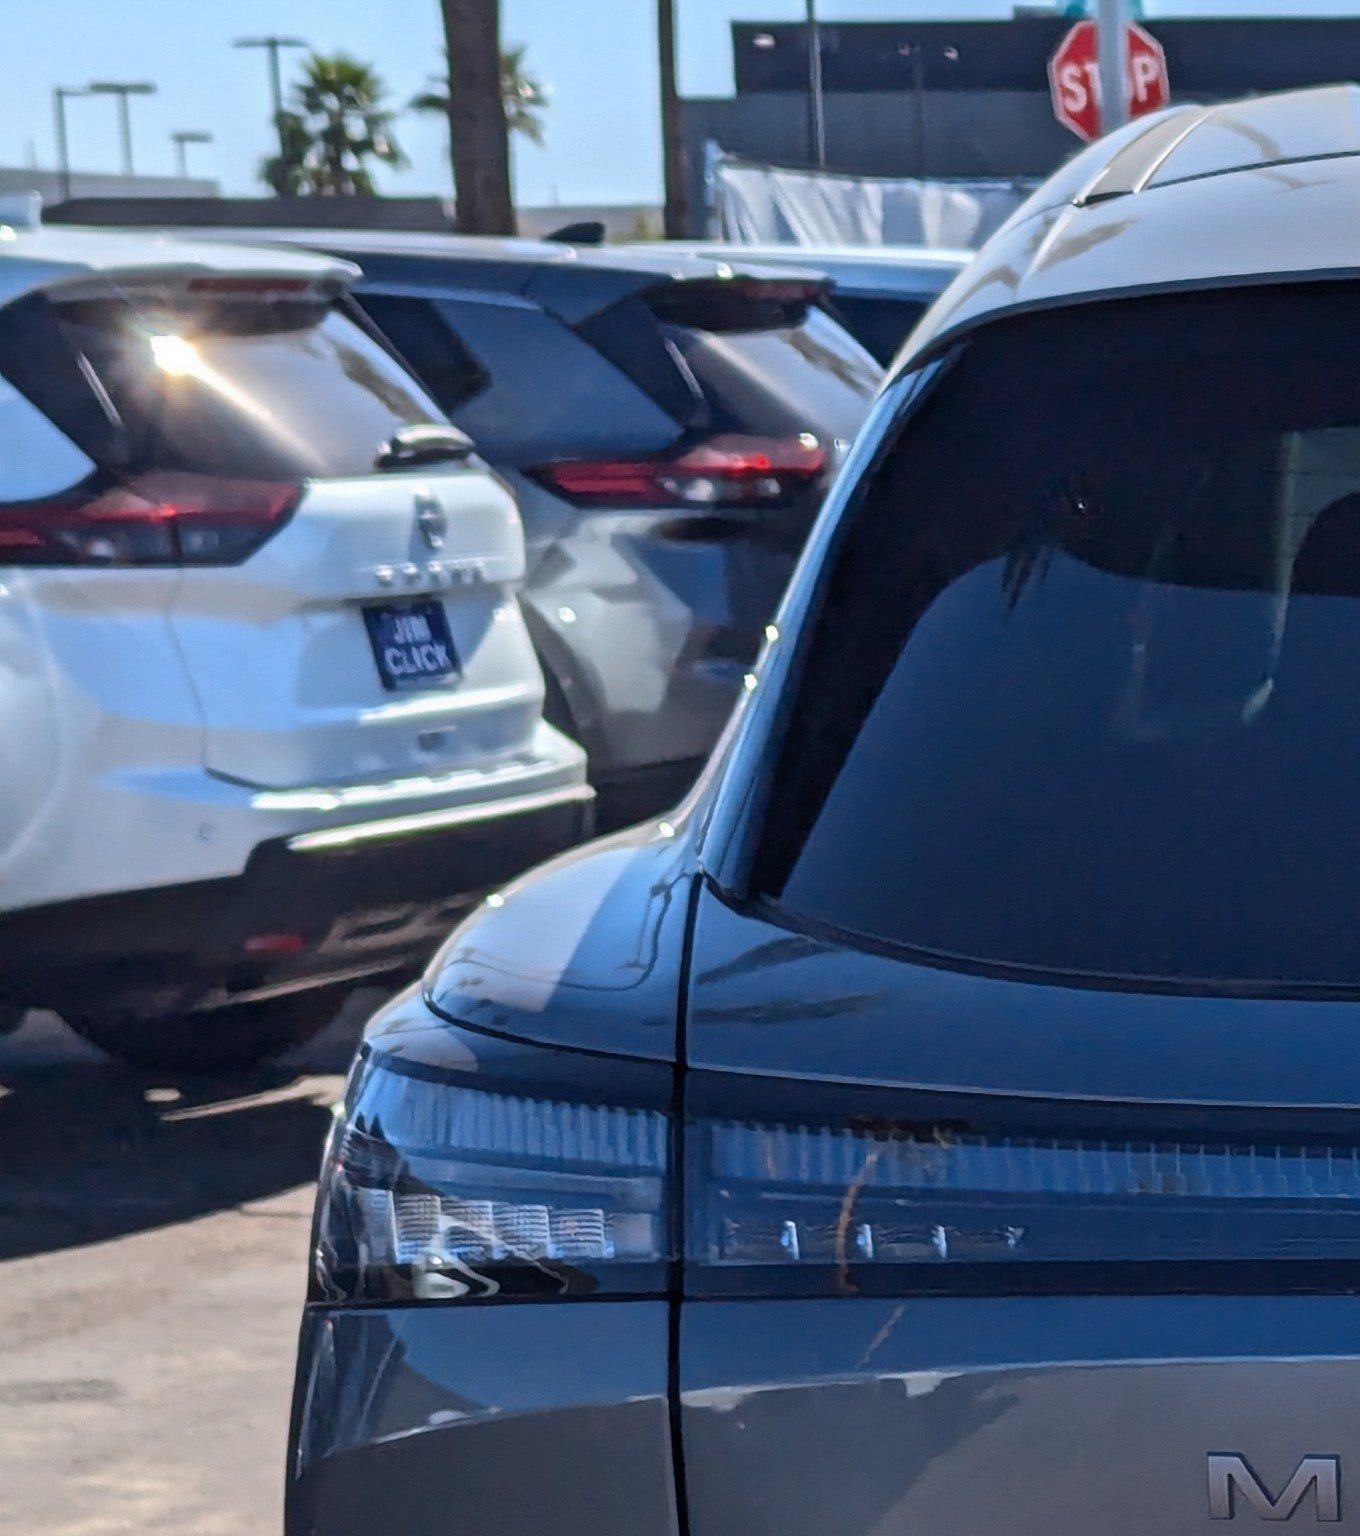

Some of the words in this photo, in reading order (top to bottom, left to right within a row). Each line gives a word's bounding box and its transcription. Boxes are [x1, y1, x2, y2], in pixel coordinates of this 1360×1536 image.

[1060, 56, 1161, 112] STP
[394, 613, 433, 645] JIM
[384, 641, 452, 676] CLICK
